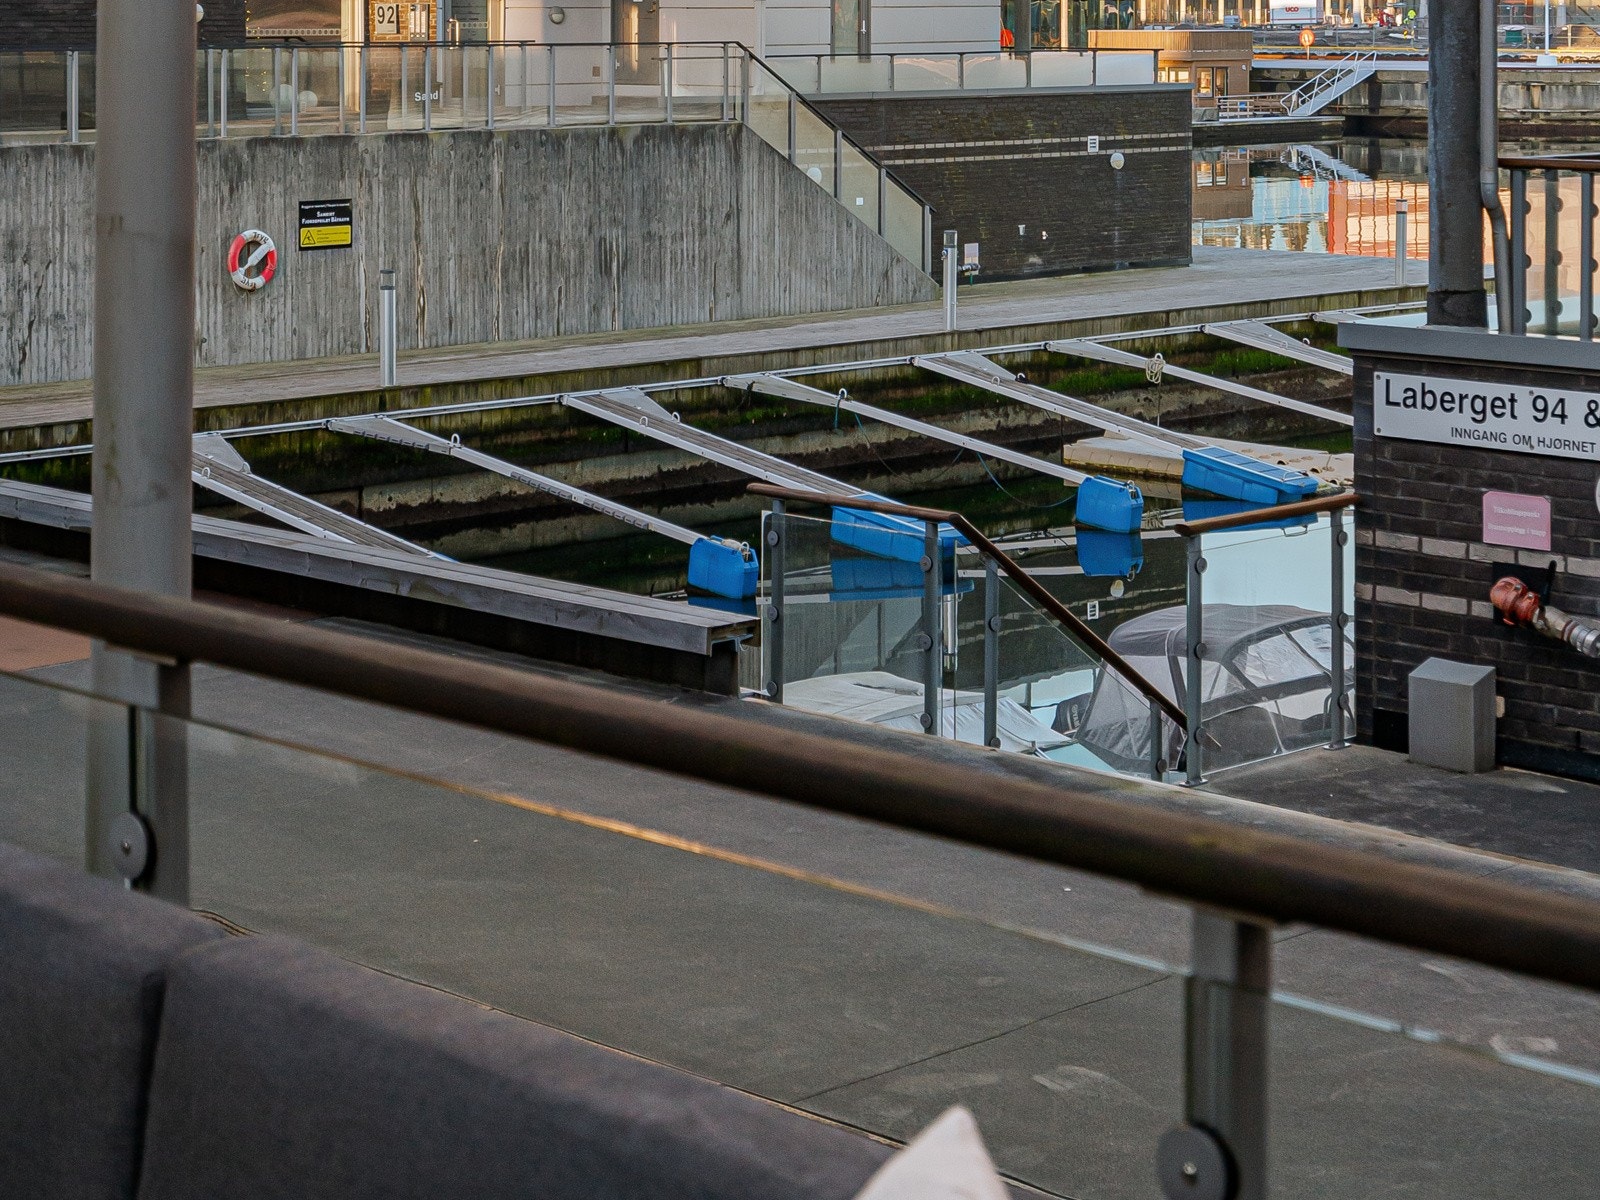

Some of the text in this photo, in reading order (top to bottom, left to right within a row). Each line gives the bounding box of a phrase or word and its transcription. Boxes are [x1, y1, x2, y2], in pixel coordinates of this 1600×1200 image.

[377, 6, 394, 24] 92
[1385, 378, 1600, 429] Laberget 94 &
[1451, 427, 1597, 454] INNGANG OM HJØRNET
